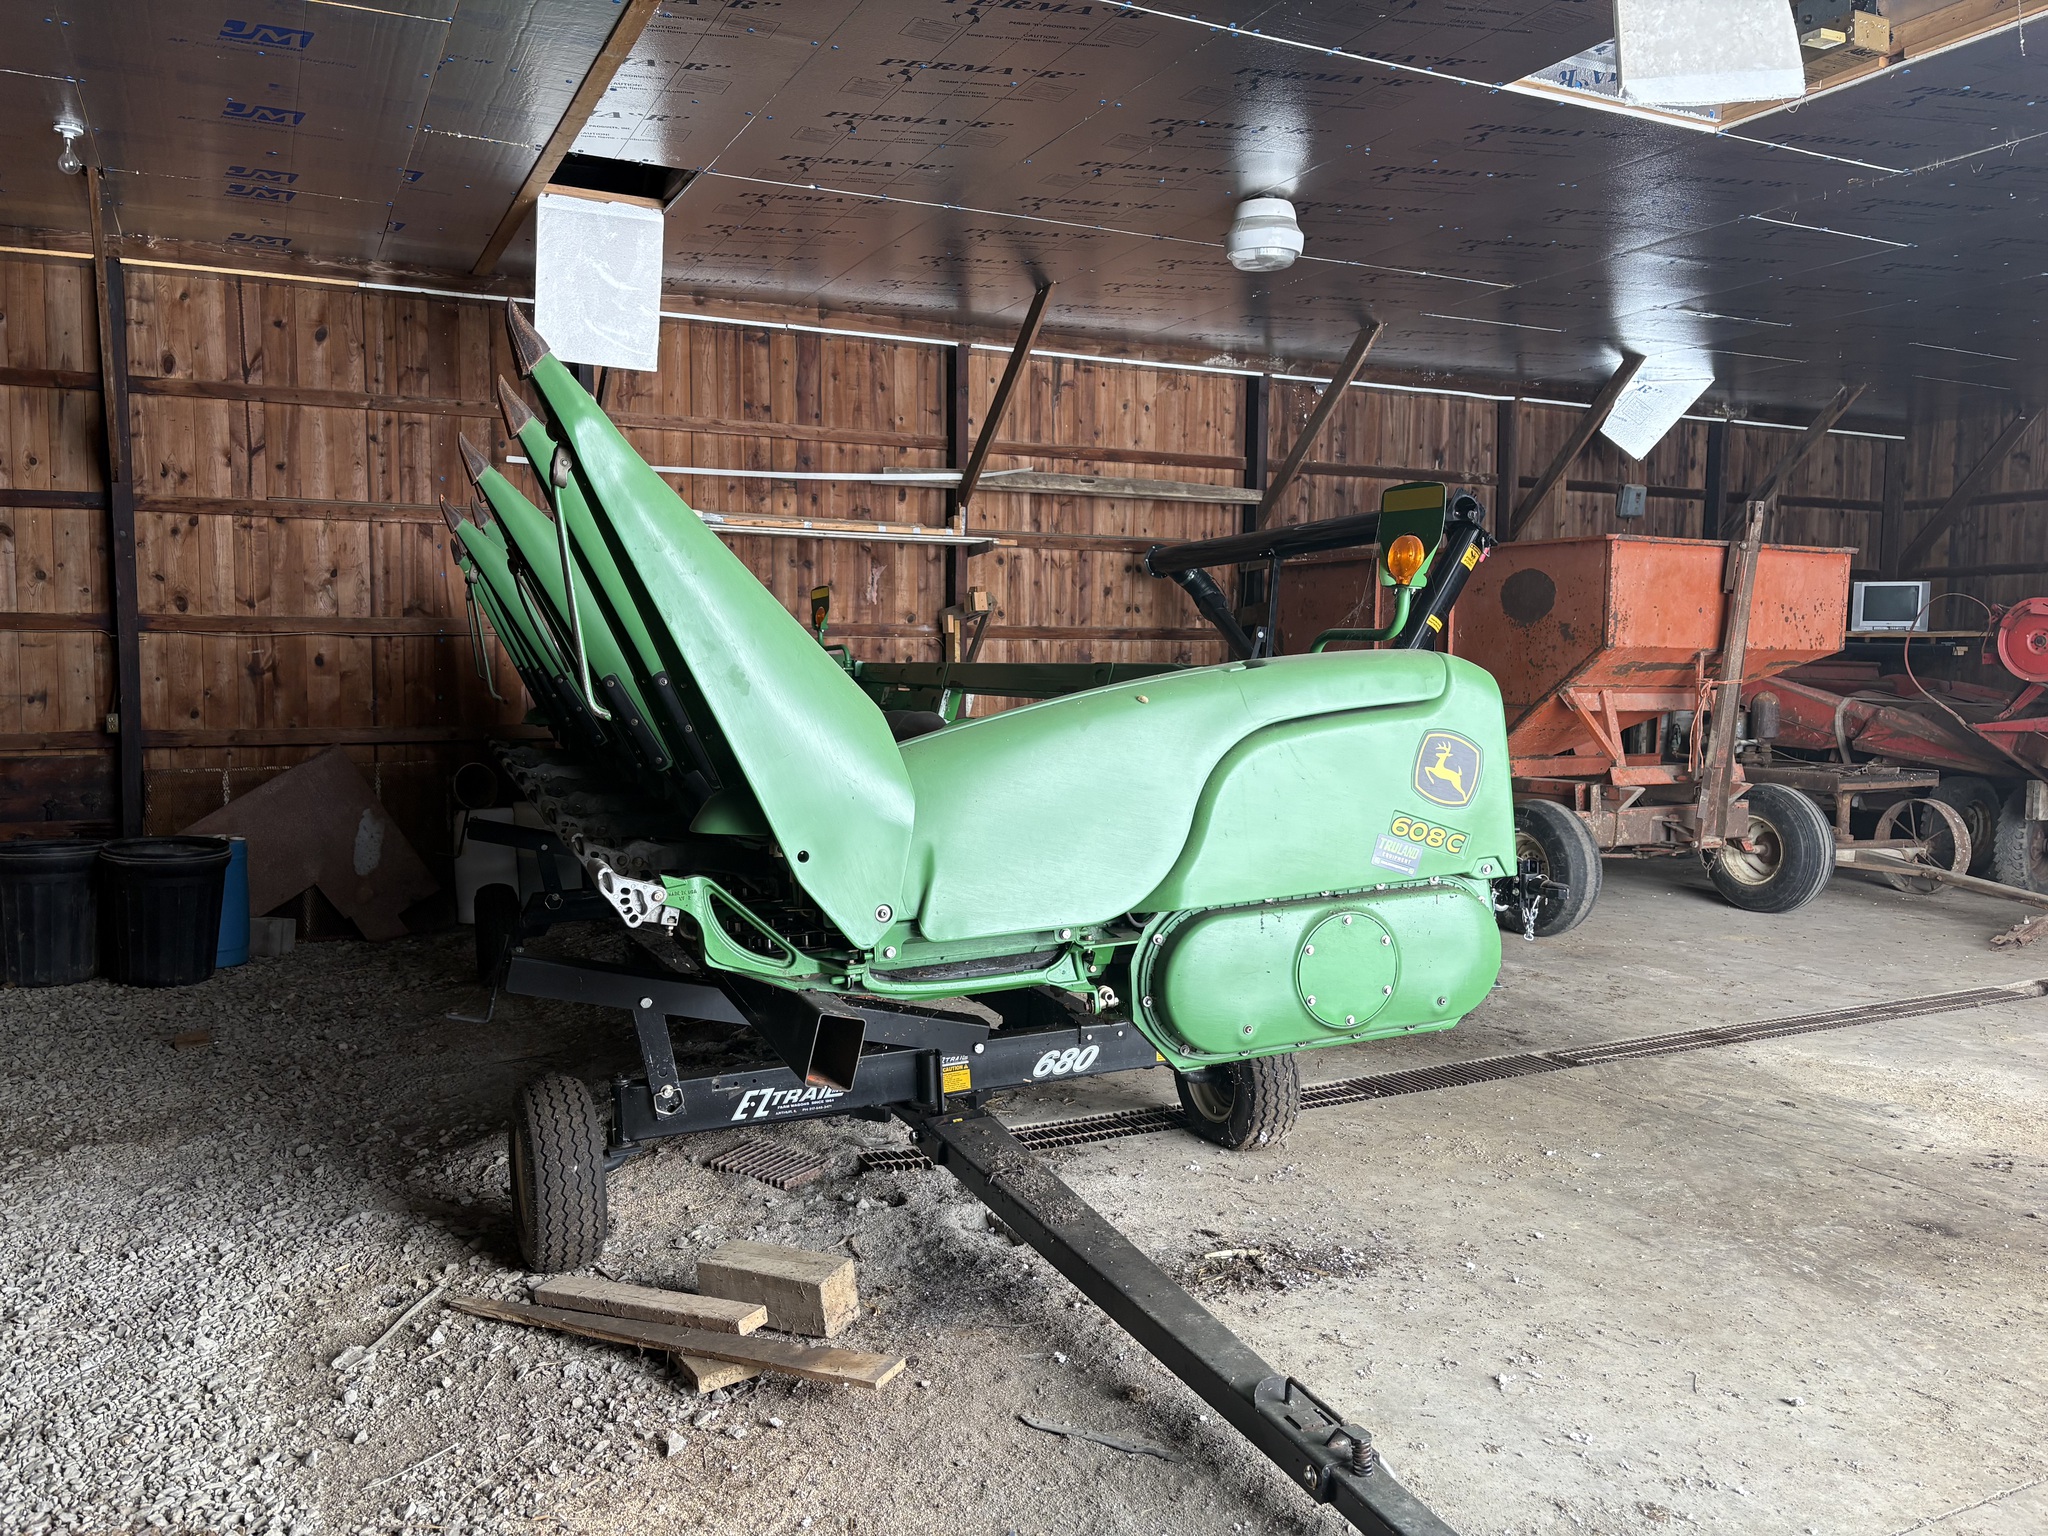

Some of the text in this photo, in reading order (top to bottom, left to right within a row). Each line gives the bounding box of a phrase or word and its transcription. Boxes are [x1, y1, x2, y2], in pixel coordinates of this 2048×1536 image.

[219, 19, 314, 48] JM
[876, 58, 1014, 75] PERMA
[221, 101, 306, 125] JM
[820, 111, 948, 125] PERMA
[776, 154, 892, 167] PERMA
[225, 165, 299, 184] JM
[1391, 816, 1467, 854] 608C
[1379, 837, 1420, 860] TRULAND
[1032, 1045, 1100, 1078] 680
